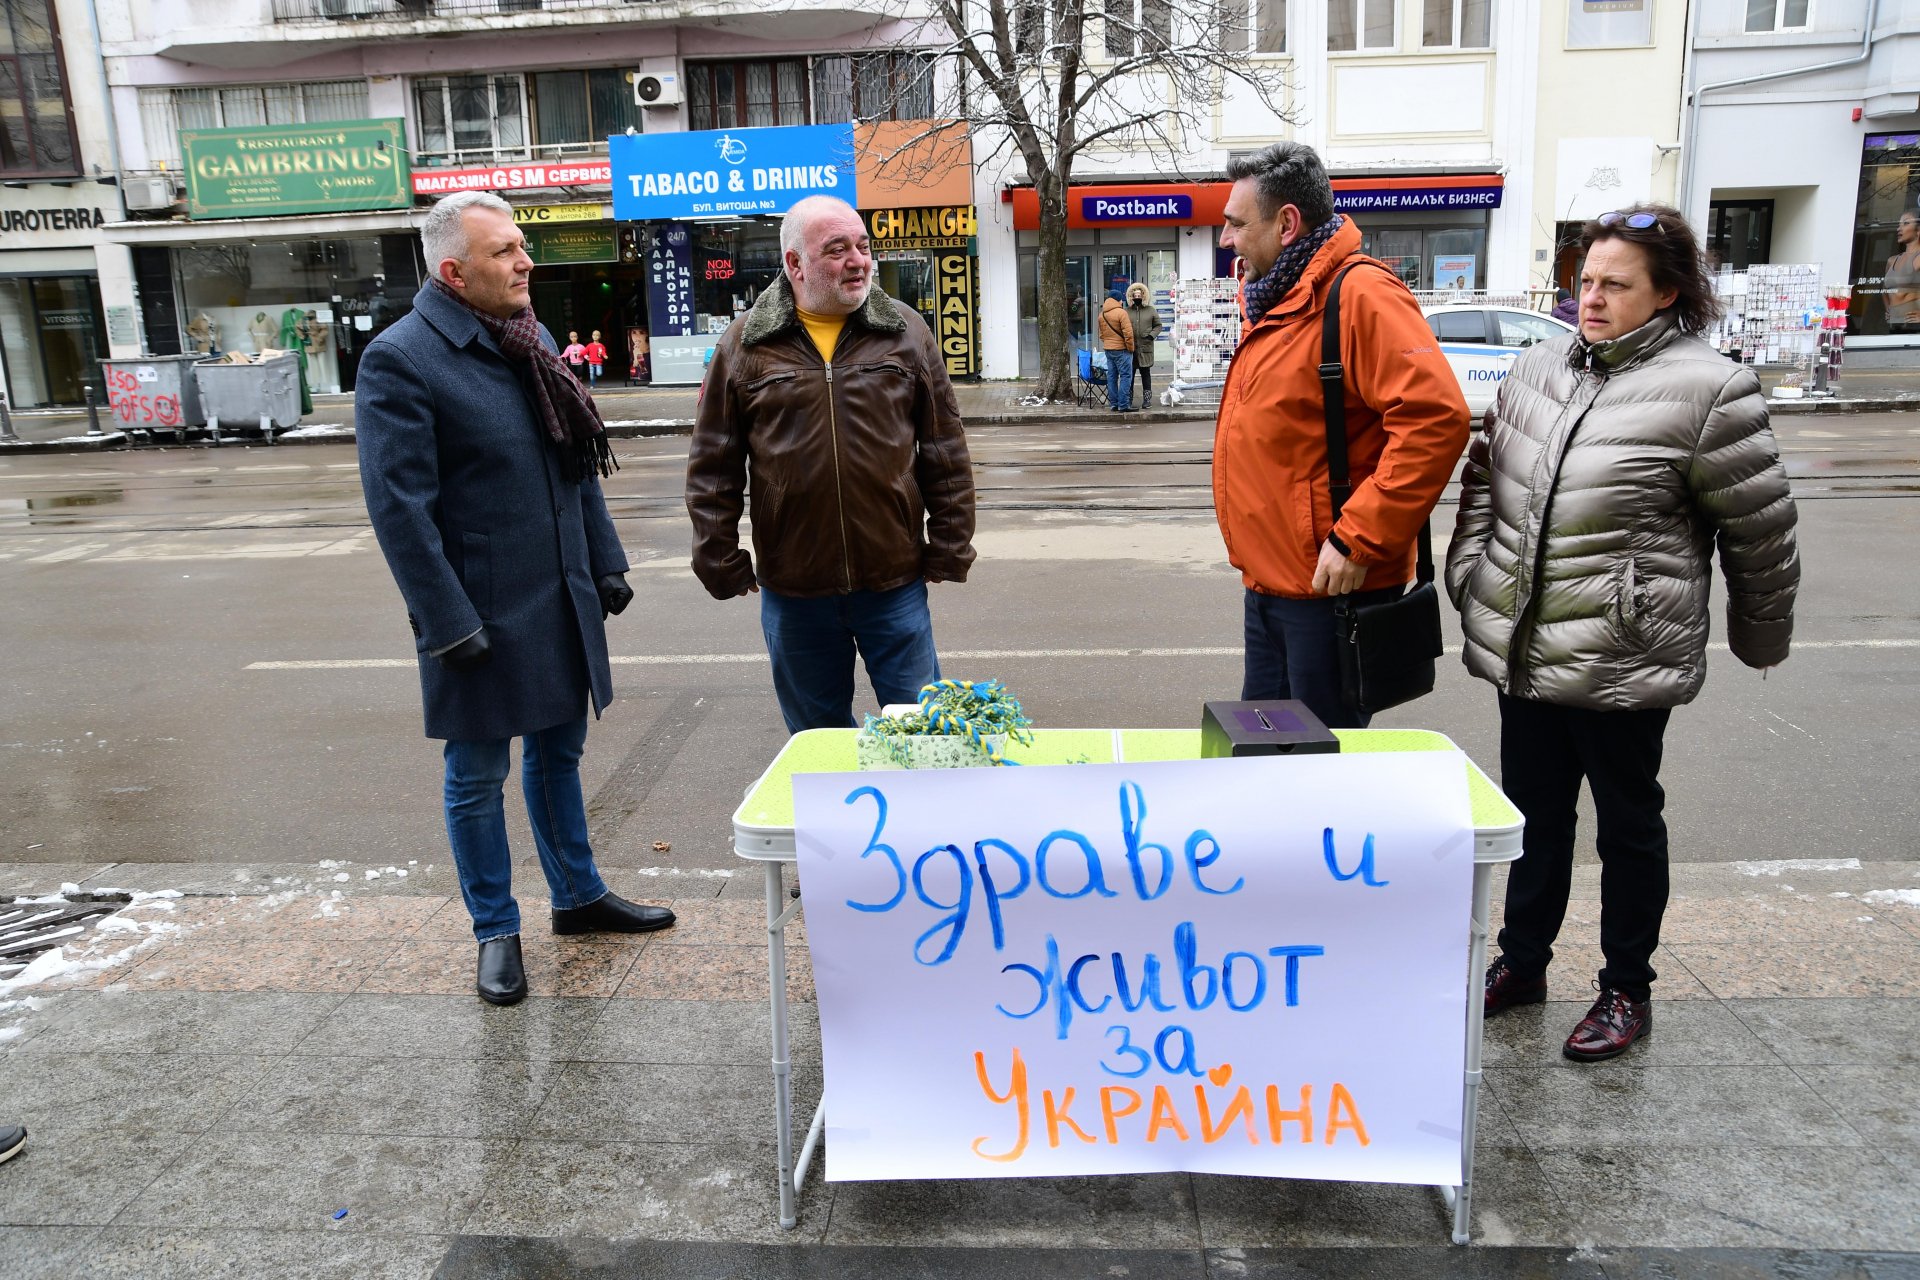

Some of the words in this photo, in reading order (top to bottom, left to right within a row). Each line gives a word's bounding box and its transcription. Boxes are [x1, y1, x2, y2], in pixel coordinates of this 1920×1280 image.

[247, 135, 335, 149] RESTAURANT
[198, 147, 393, 180] GAMBRINUS
[415, 175, 490, 191] МАГАЗИН
[492, 169, 545, 187] GSM
[548, 167, 612, 182] СЕРВИЗ
[629, 171, 719, 197] TABACO
[727, 169, 745, 192] &
[752, 165, 838, 191] DRINKS
[693, 203, 714, 213] БУЛ.
[716, 200, 757, 210] ВИТОША
[760, 200, 776, 209] №3
[1096, 199, 1178, 216] Postbank
[1401, 194, 1445, 205] МАЛЪК
[1449, 193, 1495, 204] БИЗНЕС
[668, 232, 686, 240] 24/7
[871, 207, 976, 239] CHANGE
[873, 241, 916, 249] MONEY
[920, 237, 967, 246] CENTER
[651, 237, 664, 283] КАФЕ
[705, 270, 734, 280] STOP
[707, 260, 731, 269] NON
[665, 249, 679, 325] АЛКОХОЛ
[678, 266, 692, 336] ЦИГАРИ
[45, 315, 86, 324] VITOSHA
[941, 255, 968, 375] CHANGE
[845, 780, 1245, 966] Здраве
[1323, 826, 1389, 886] и
[996, 922, 1325, 1040] живот
[1100, 1025, 1206, 1078] за
[971, 1047, 1370, 1163] УКРАЙНА
